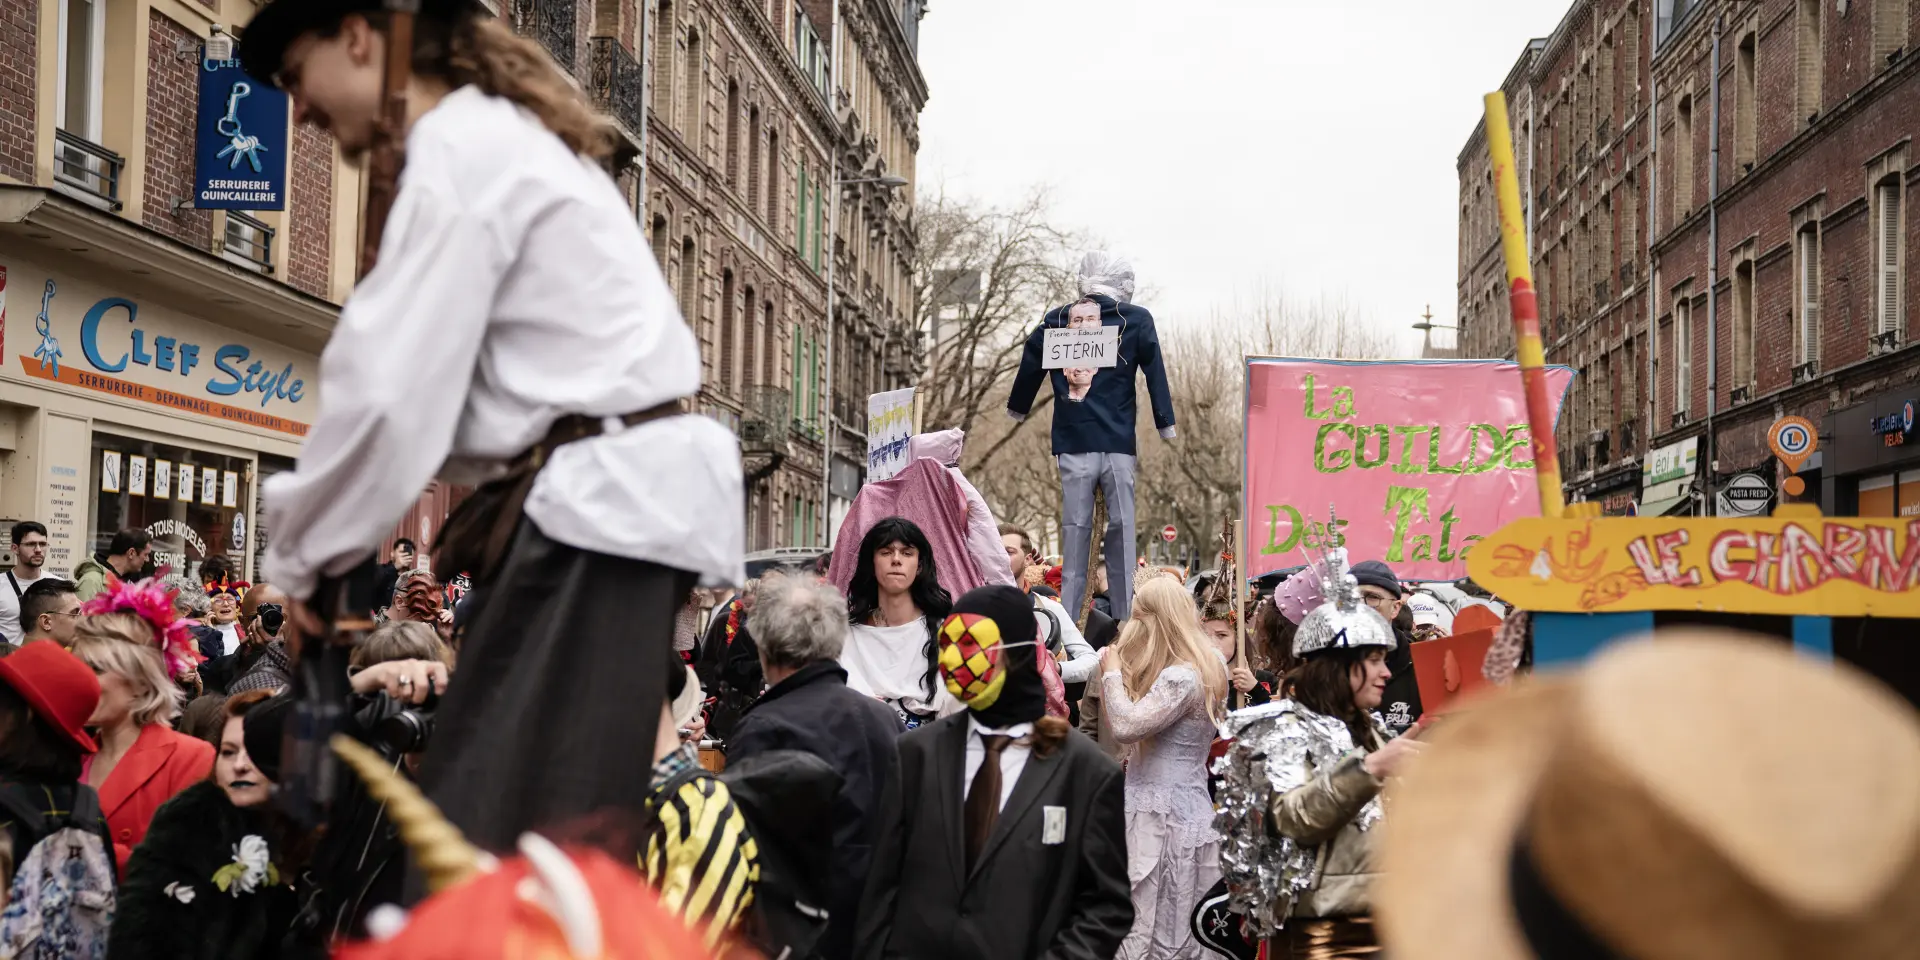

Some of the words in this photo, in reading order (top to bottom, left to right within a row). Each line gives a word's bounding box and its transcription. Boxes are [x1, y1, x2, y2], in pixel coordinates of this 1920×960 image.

[201, 190, 277, 202] QUINCAILLERIE
[208, 179, 270, 191] SERRURERIE
[80, 297, 200, 376] CLEF
[205, 344, 304, 407] Style
[78, 373, 143, 398] SERRURERIE
[156, 391, 210, 413] DEPANNAGE
[221, 406, 281, 429] QUINCAILLERIE
[1303, 374, 1357, 419] La
[1314, 422, 1536, 476] GUILDE
[1730, 488, 1748, 498] PASTA
[1749, 488, 1768, 498] FRESH
[154, 519, 174, 537] TOUS
[175, 520, 207, 558] MODELES
[1261, 504, 1349, 555] Des
[153, 551, 186, 569] SERVICE
[1627, 528, 1702, 586] LE
[1389, 701, 1411, 714] STAY
